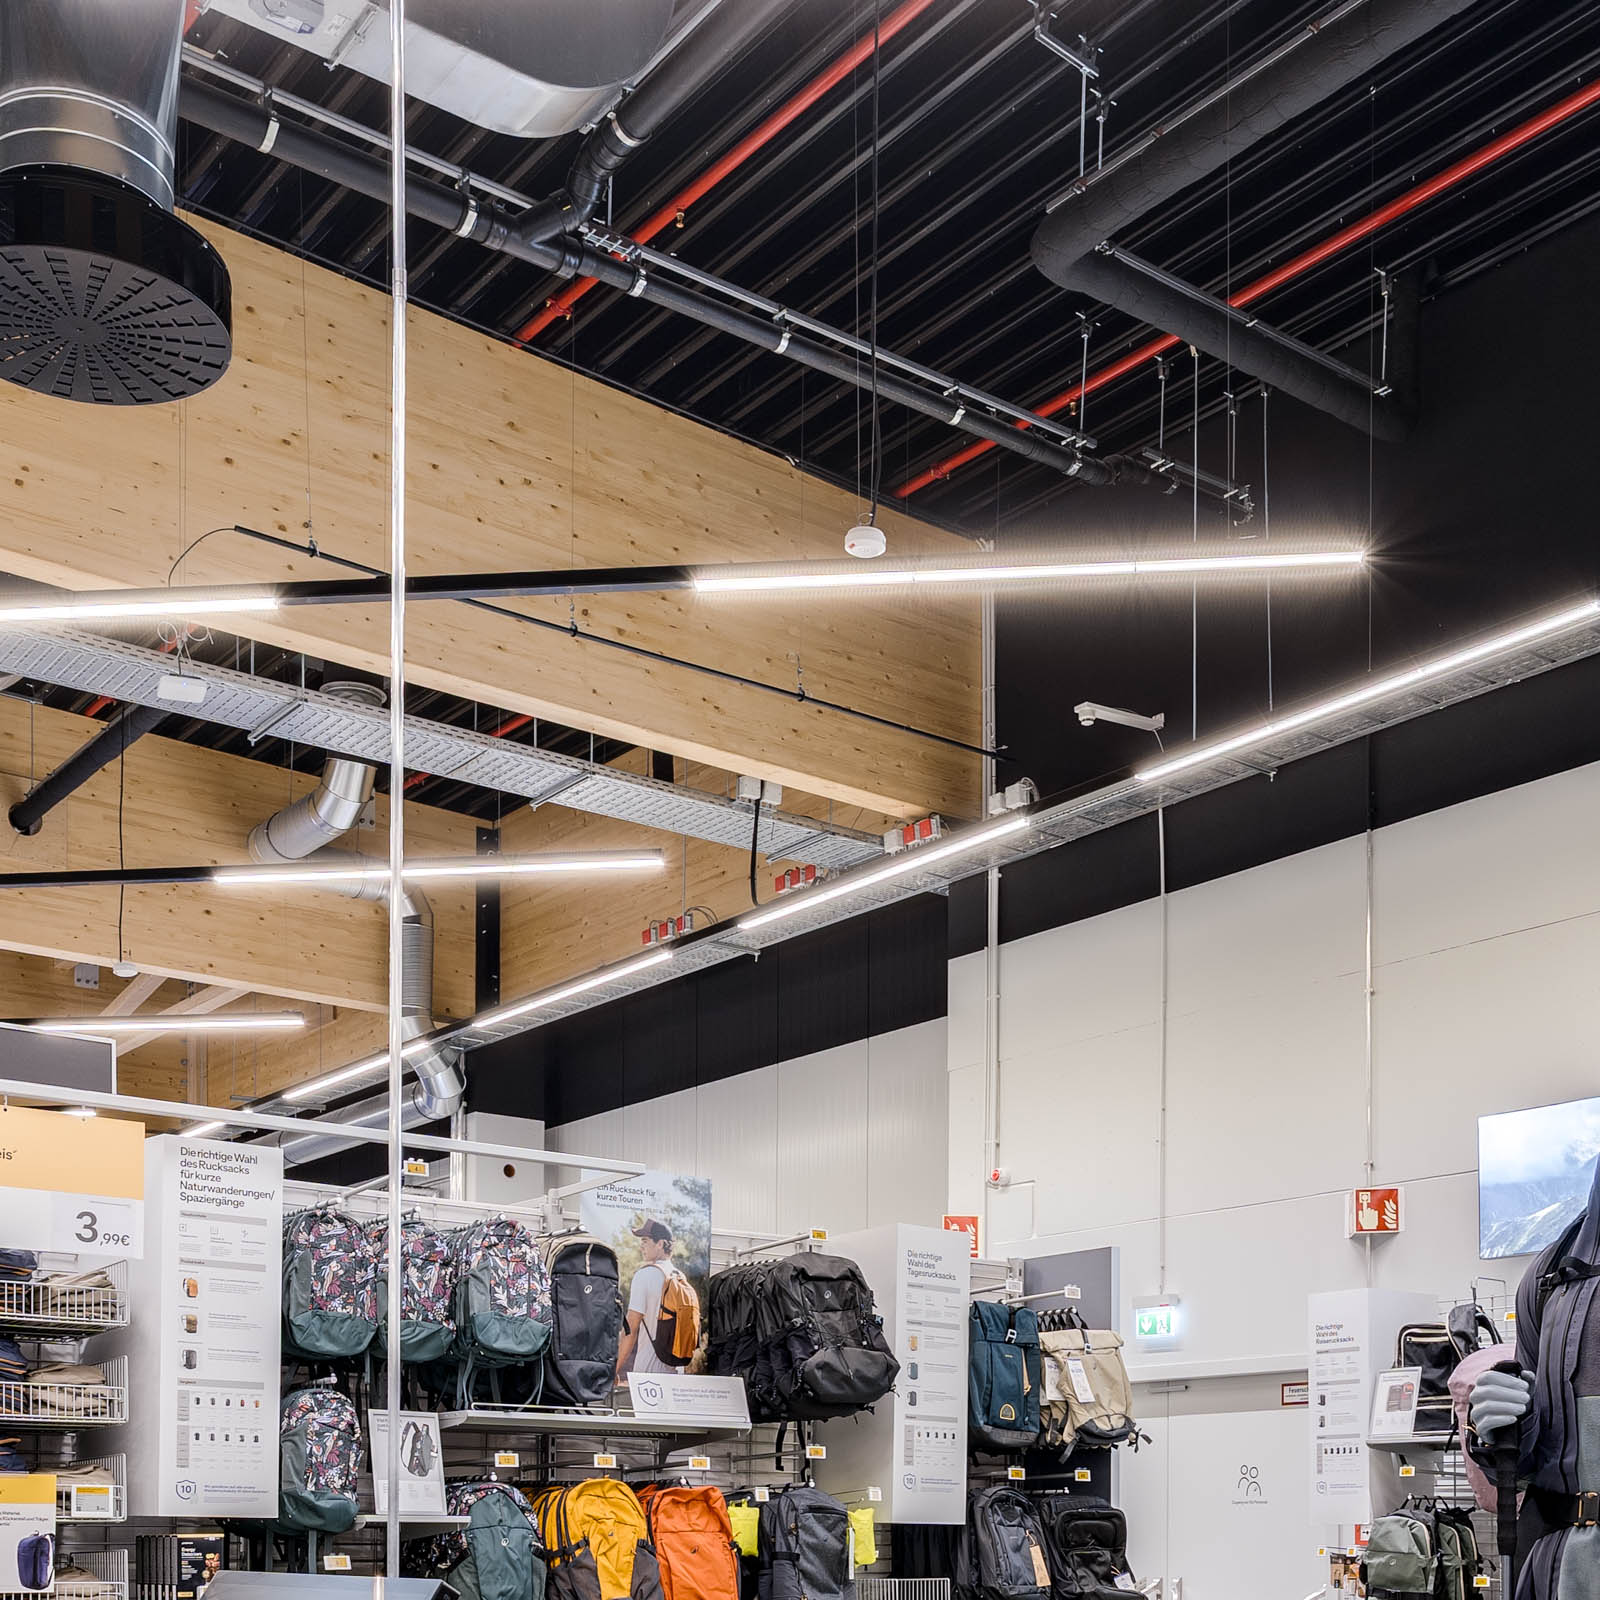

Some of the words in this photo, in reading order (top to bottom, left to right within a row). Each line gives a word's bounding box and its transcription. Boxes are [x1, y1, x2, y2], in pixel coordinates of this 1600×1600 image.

[180, 1147, 196, 1157] Die
[197, 1149, 233, 1163] richtige
[234, 1153, 258, 1165] Wahl
[180, 1158, 198, 1169] des
[199, 1160, 250, 1175] Rucksacks
[180, 1170, 194, 1179] für
[195, 1171, 222, 1182] kurze
[180, 1181, 275, 1201] Naturwanderungen/
[610, 1184, 644, 1195] Rucksack
[180, 1192, 245, 1208] Spaziergänge
[597, 1192, 617, 1201] kurze
[618, 1194, 643, 1205] Touren
[74, 1211, 130, 1247] 3,99€
[907, 1250, 918, 1258] Die
[920, 1251, 942, 1262] richtige
[907, 1259, 923, 1268] Wahl
[924, 1260, 936, 1269] des
[907, 1268, 956, 1280] Tagesrucksacks
[644, 1387, 657, 1398] 10
[181, 1485, 192, 1494] 10
